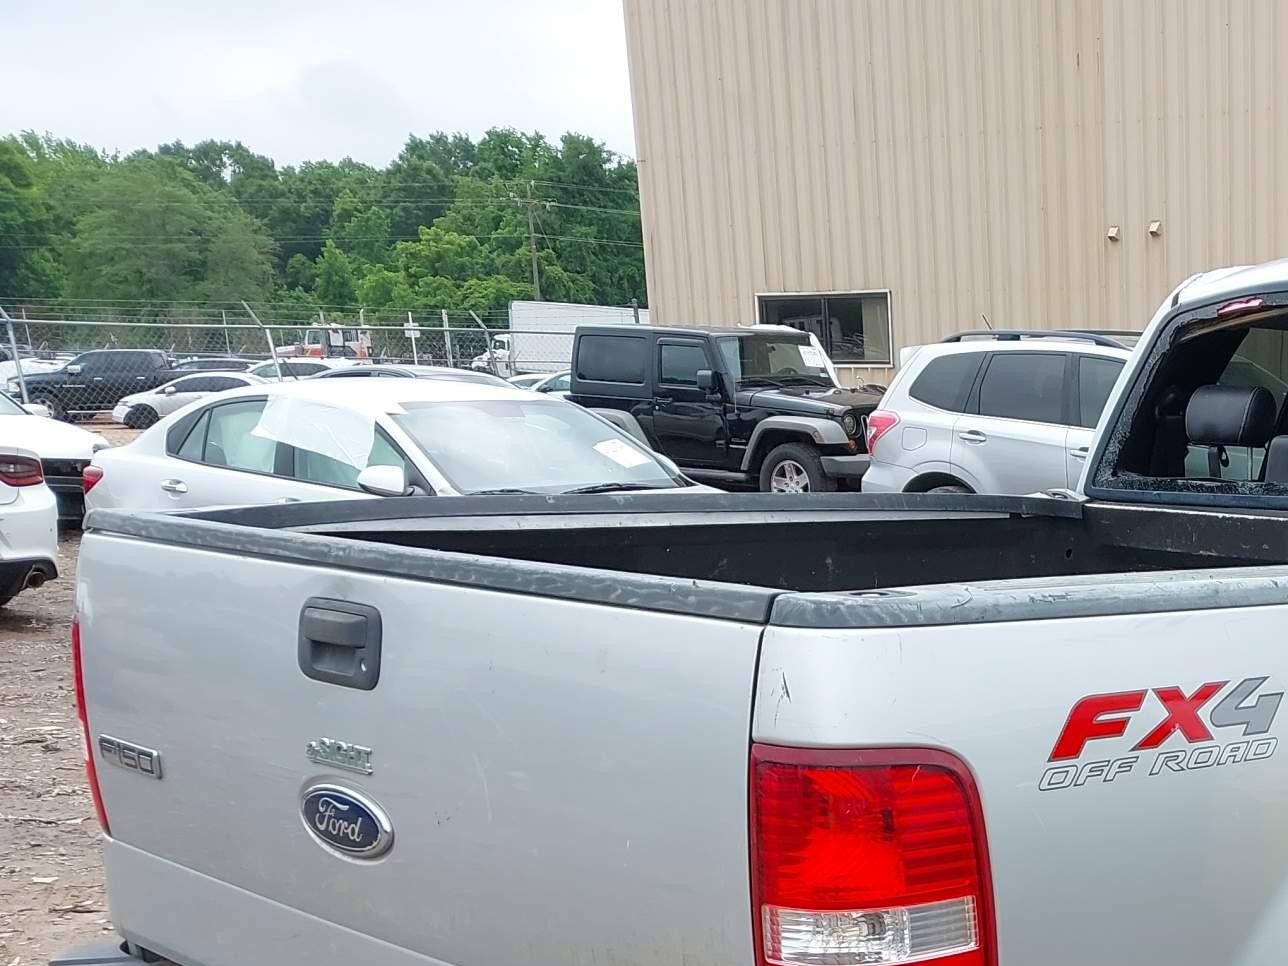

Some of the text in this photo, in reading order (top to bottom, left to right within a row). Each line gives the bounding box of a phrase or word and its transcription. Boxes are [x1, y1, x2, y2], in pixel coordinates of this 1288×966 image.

[1047, 676, 1284, 763] FX4
[1039, 737, 1279, 791] OFF ROAD
[315, 796, 363, 842] Ford
